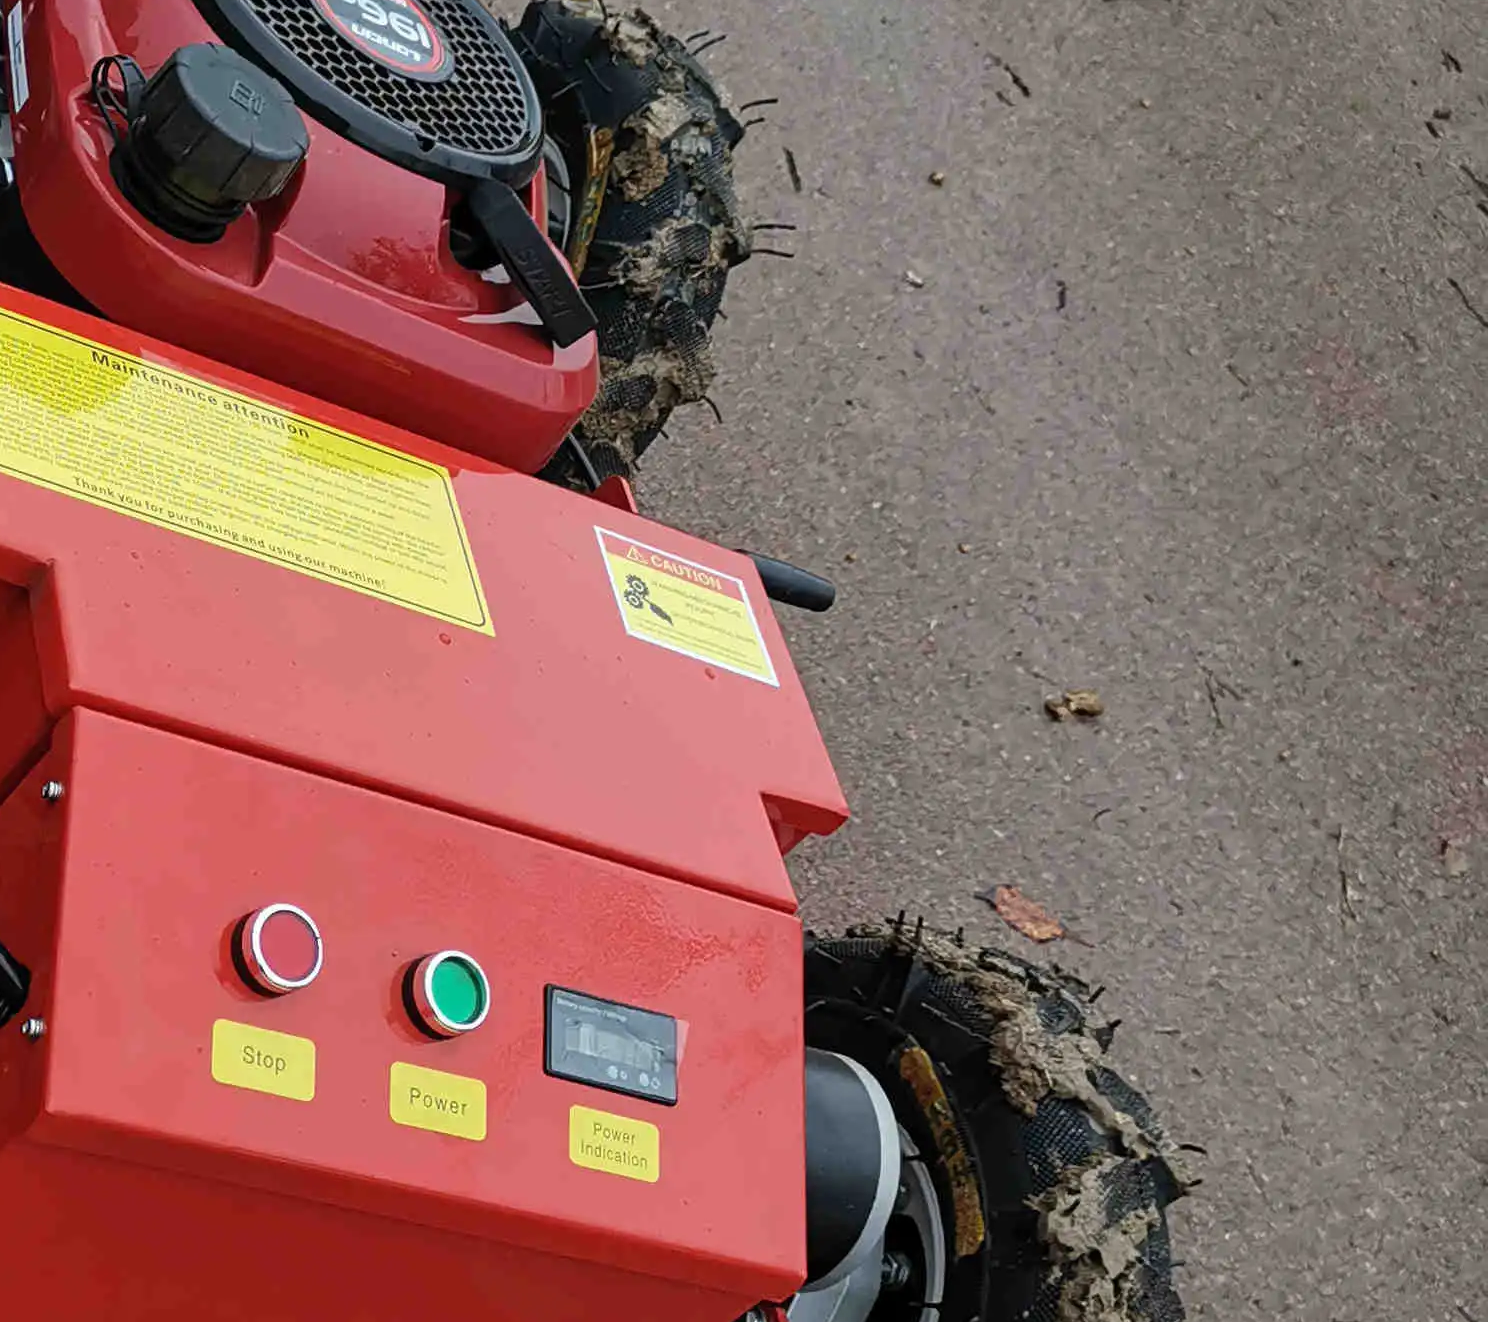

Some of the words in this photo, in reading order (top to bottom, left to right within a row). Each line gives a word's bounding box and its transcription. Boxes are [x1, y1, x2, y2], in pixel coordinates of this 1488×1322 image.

[91, 350, 218, 406] Maintenance
[222, 399, 311, 439] attention
[74, 476, 114, 498] Thank
[118, 493, 143, 508] you
[144, 499, 164, 515] for
[167, 509, 240, 542] purchasing
[242, 533, 265, 550] and
[268, 543, 303, 563] using
[304, 555, 326, 569] our
[650, 554, 723, 591] CAUTION
[242, 1044, 287, 1075] Stop
[409, 1086, 468, 1116] Power
[593, 1121, 636, 1146] Power
[580, 1138, 648, 1170] Indication
